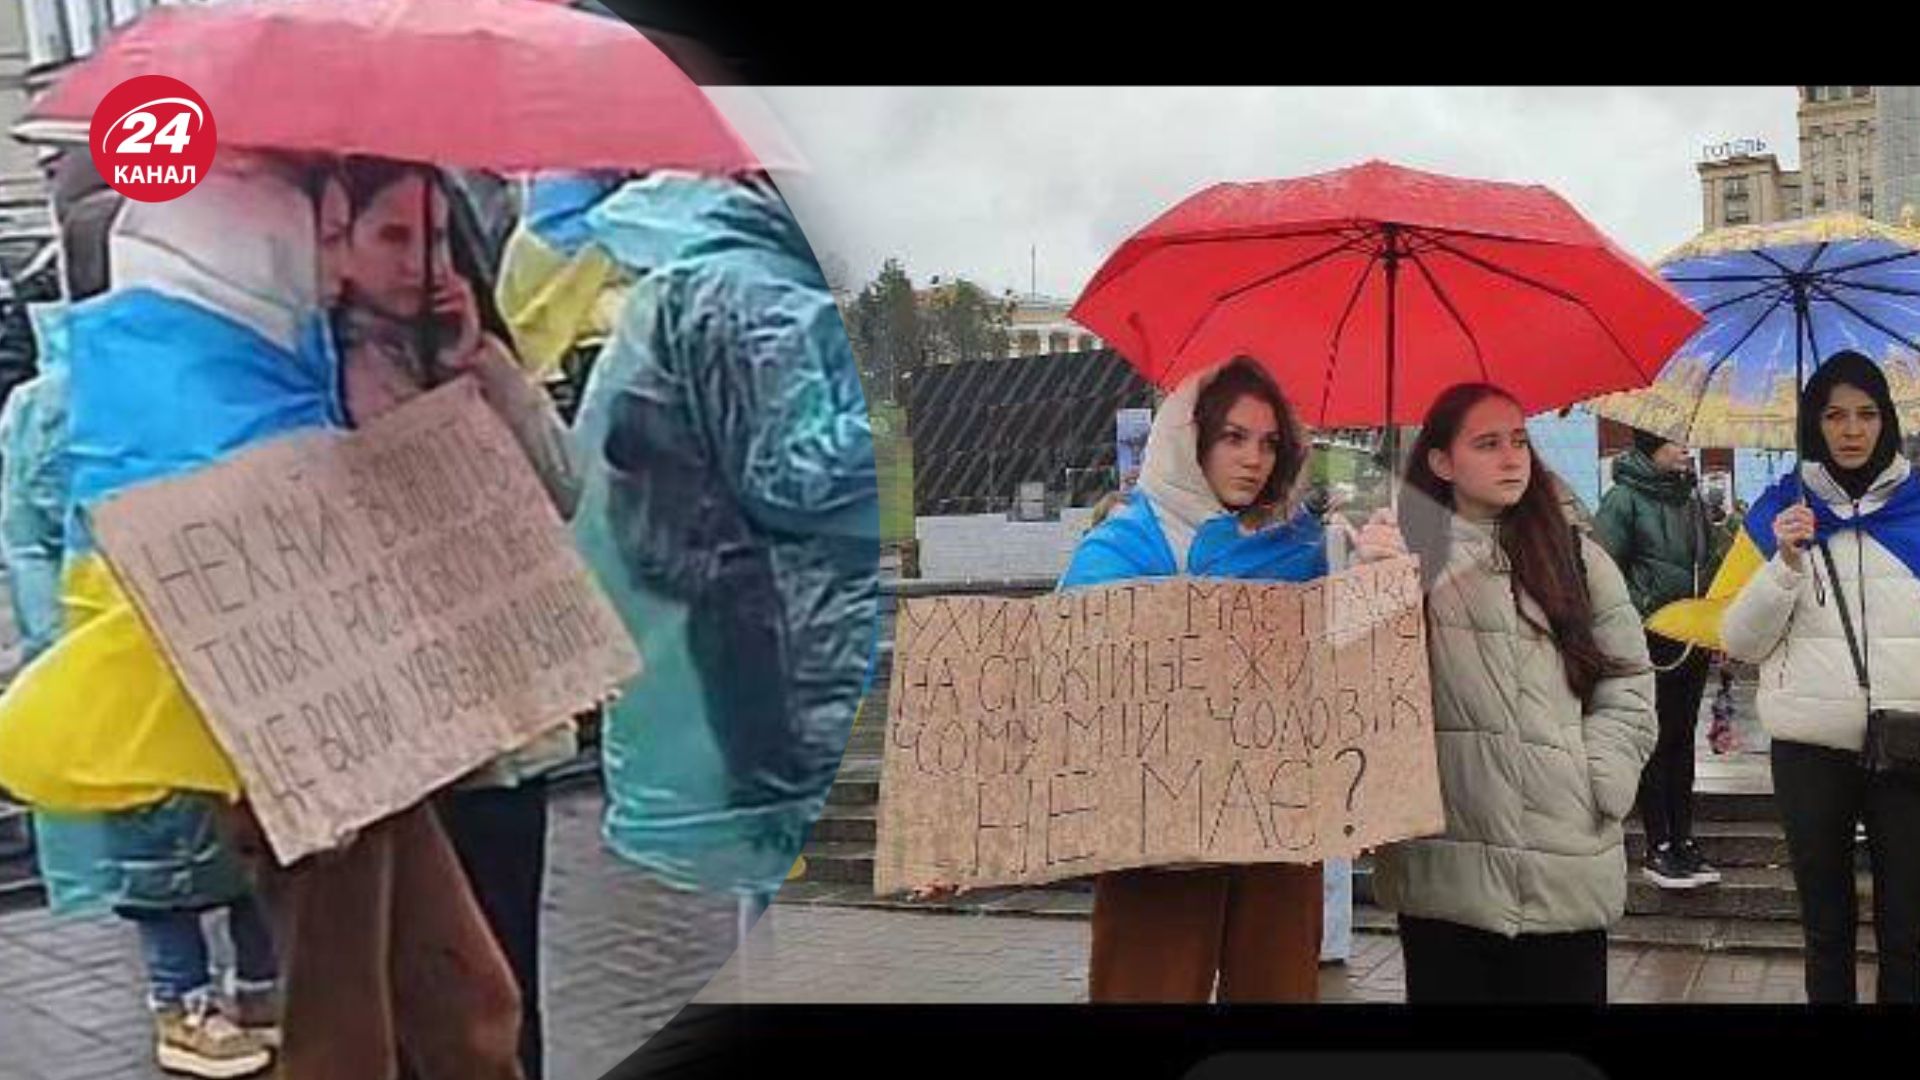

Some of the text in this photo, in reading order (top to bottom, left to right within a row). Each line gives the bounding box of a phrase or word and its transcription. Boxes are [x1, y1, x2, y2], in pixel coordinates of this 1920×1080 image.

[141, 470, 355, 624] НЕХАЙ
[893, 674, 1421, 777] ЧОМУ МІЙ ЧОЛОВІК
[898, 653, 960, 721] НА
[240, 712, 317, 815] ЦЕ
[310, 675, 397, 775] ВОНИ
[972, 769, 1098, 875] НЕ
